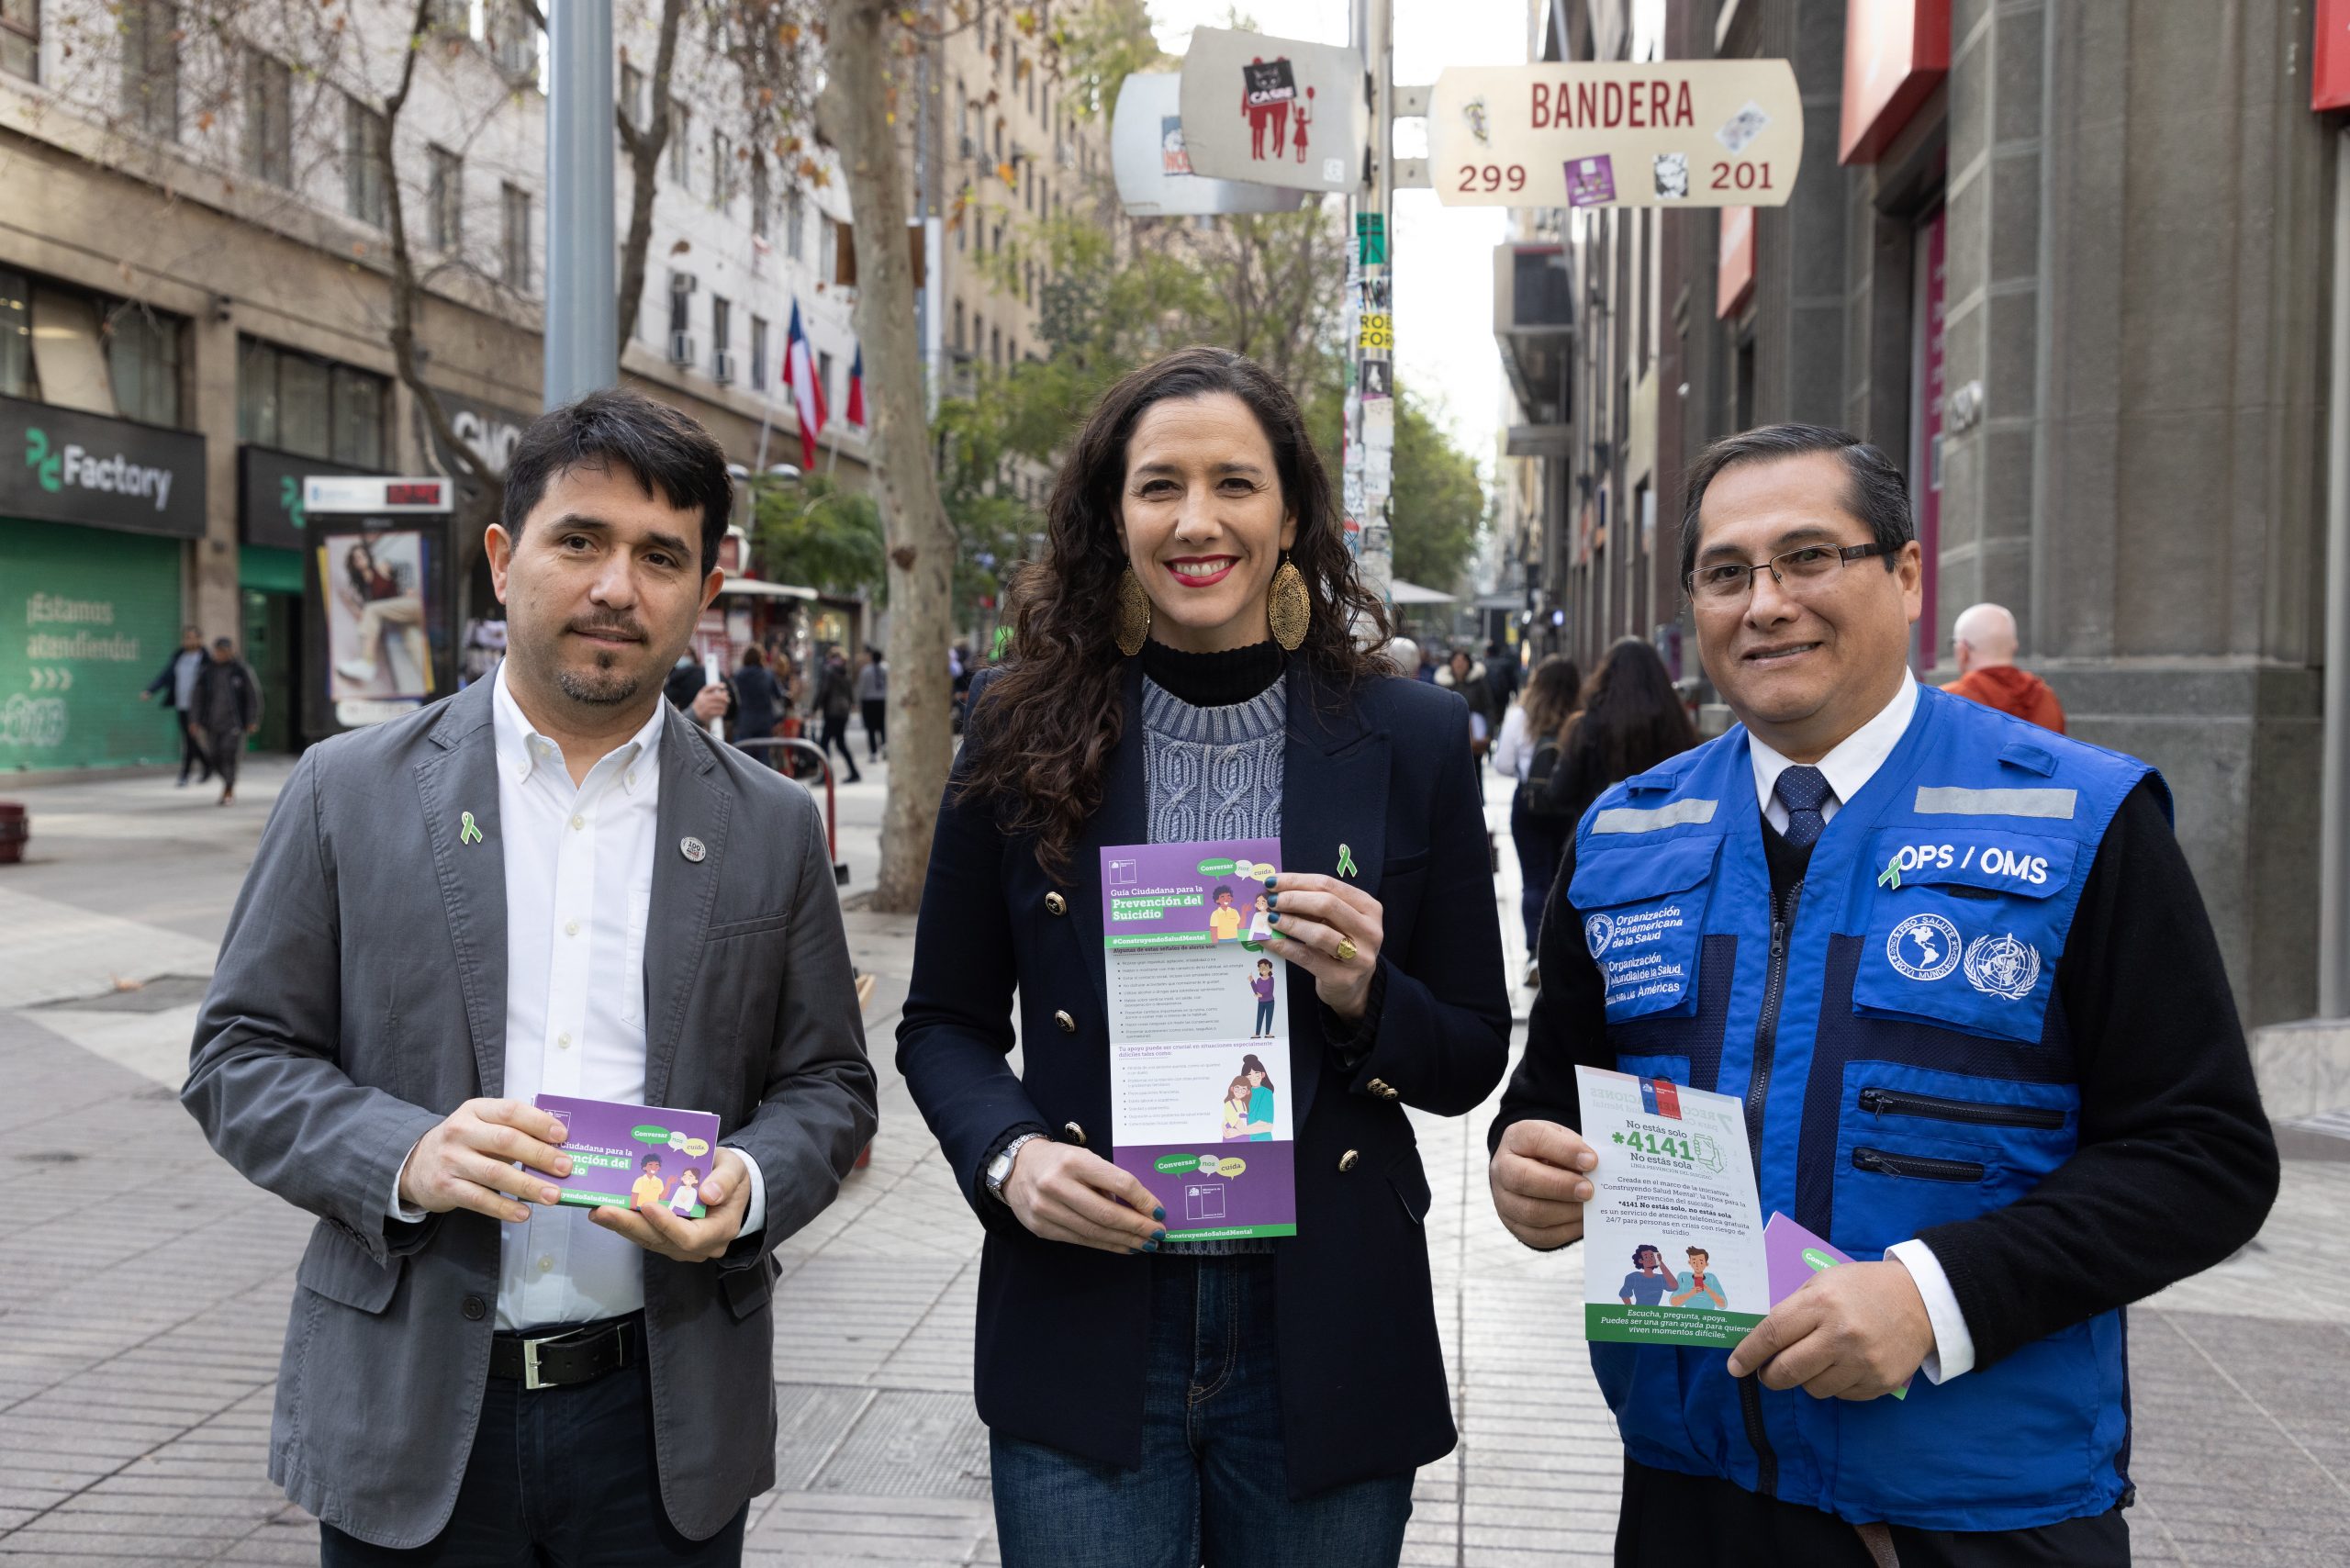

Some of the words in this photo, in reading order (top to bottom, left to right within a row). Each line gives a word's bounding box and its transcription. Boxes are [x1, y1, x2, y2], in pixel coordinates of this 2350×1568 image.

[1531, 81, 1695, 129] BANDERA
[1459, 165, 1527, 192] 299
[1711, 162, 1774, 190] 201
[63, 444, 173, 512] Factory
[27, 592, 115, 626] ¡Estamos
[27, 633, 140, 661] atendiendo!
[1201, 863, 1234, 872] Conversar
[1897, 845, 1954, 871] OPS
[1961, 846, 1975, 869] /
[1981, 847, 2048, 884] OMS
[1111, 889, 1129, 897] Guía
[1131, 887, 1175, 895] Ciudadana
[1177, 887, 1194, 895] para
[1113, 896, 1181, 909] Prevención
[1184, 895, 1202, 905] del
[1113, 910, 1161, 920] Suicidio
[1617, 906, 1680, 926] Organización
[1614, 919, 1683, 936] Panamericana
[1898, 920, 1918, 933] PRO
[1921, 917, 1955, 938] SALUTE
[1113, 935, 1205, 945] #ConstruyendoSaludMental
[1612, 938, 1624, 948] de
[1625, 936, 1633, 946] la
[1635, 930, 1662, 944] Salud
[1609, 952, 1662, 972] Organización
[1895, 960, 1914, 977] NOVI
[1919, 968, 1947, 979] MUNDI
[1610, 969, 1639, 985] Mundial
[1640, 969, 1650, 979] de
[1651, 969, 1657, 977] la
[1658, 964, 1681, 975] Salud
[1638, 981, 1680, 998] Américas
[634, 1130, 667, 1138] Conversar
[1626, 1120, 1640, 1129] No
[1643, 1124, 1666, 1135] estás
[1668, 1128, 1687, 1138] solo
[561, 1141, 604, 1153] Ciudadana
[606, 1147, 623, 1157] para
[625, 1148, 632, 1157] la
[570, 1153, 608, 1166] nción
[611, 1158, 629, 1169] del
[1158, 1159, 1196, 1170] Conversar
[1630, 1153, 1645, 1162] No
[1647, 1157, 1672, 1167] estás
[1673, 1160, 1692, 1170] sola
[561, 1192, 625, 1205] yendoSaludMental
[1653, 1187, 1672, 1195] Salud
[1724, 1199, 1739, 1207] para
[1698, 1186, 1729, 1197] iniciativa
[1636, 1194, 1674, 1204] prevención
[1687, 1198, 1714, 1209] suicidio
[1620, 1209, 1648, 1217] servicio
[1659, 1212, 1688, 1220] atención
[1689, 1215, 1723, 1225] telefónica
[1724, 1218, 1750, 1229] gratuita
[1671, 1204, 1687, 1213] solo,
[1699, 1208, 1717, 1216] estás
[1718, 1211, 1732, 1219] sola
[1165, 1229, 1253, 1239] ConstruyendoSaludMental
[1639, 1219, 1670, 1227] personas
[1715, 1226, 1736, 1236] riesgo
[1807, 1253, 1831, 1269] Conve
[1628, 1310, 1661, 1318] Escucha,
[1662, 1313, 1700, 1322] pregunta,
[1702, 1316, 1728, 1324] apoya.
[1652, 1327, 1694, 1336] momentos
[1695, 1329, 1727, 1339] difíciles.
